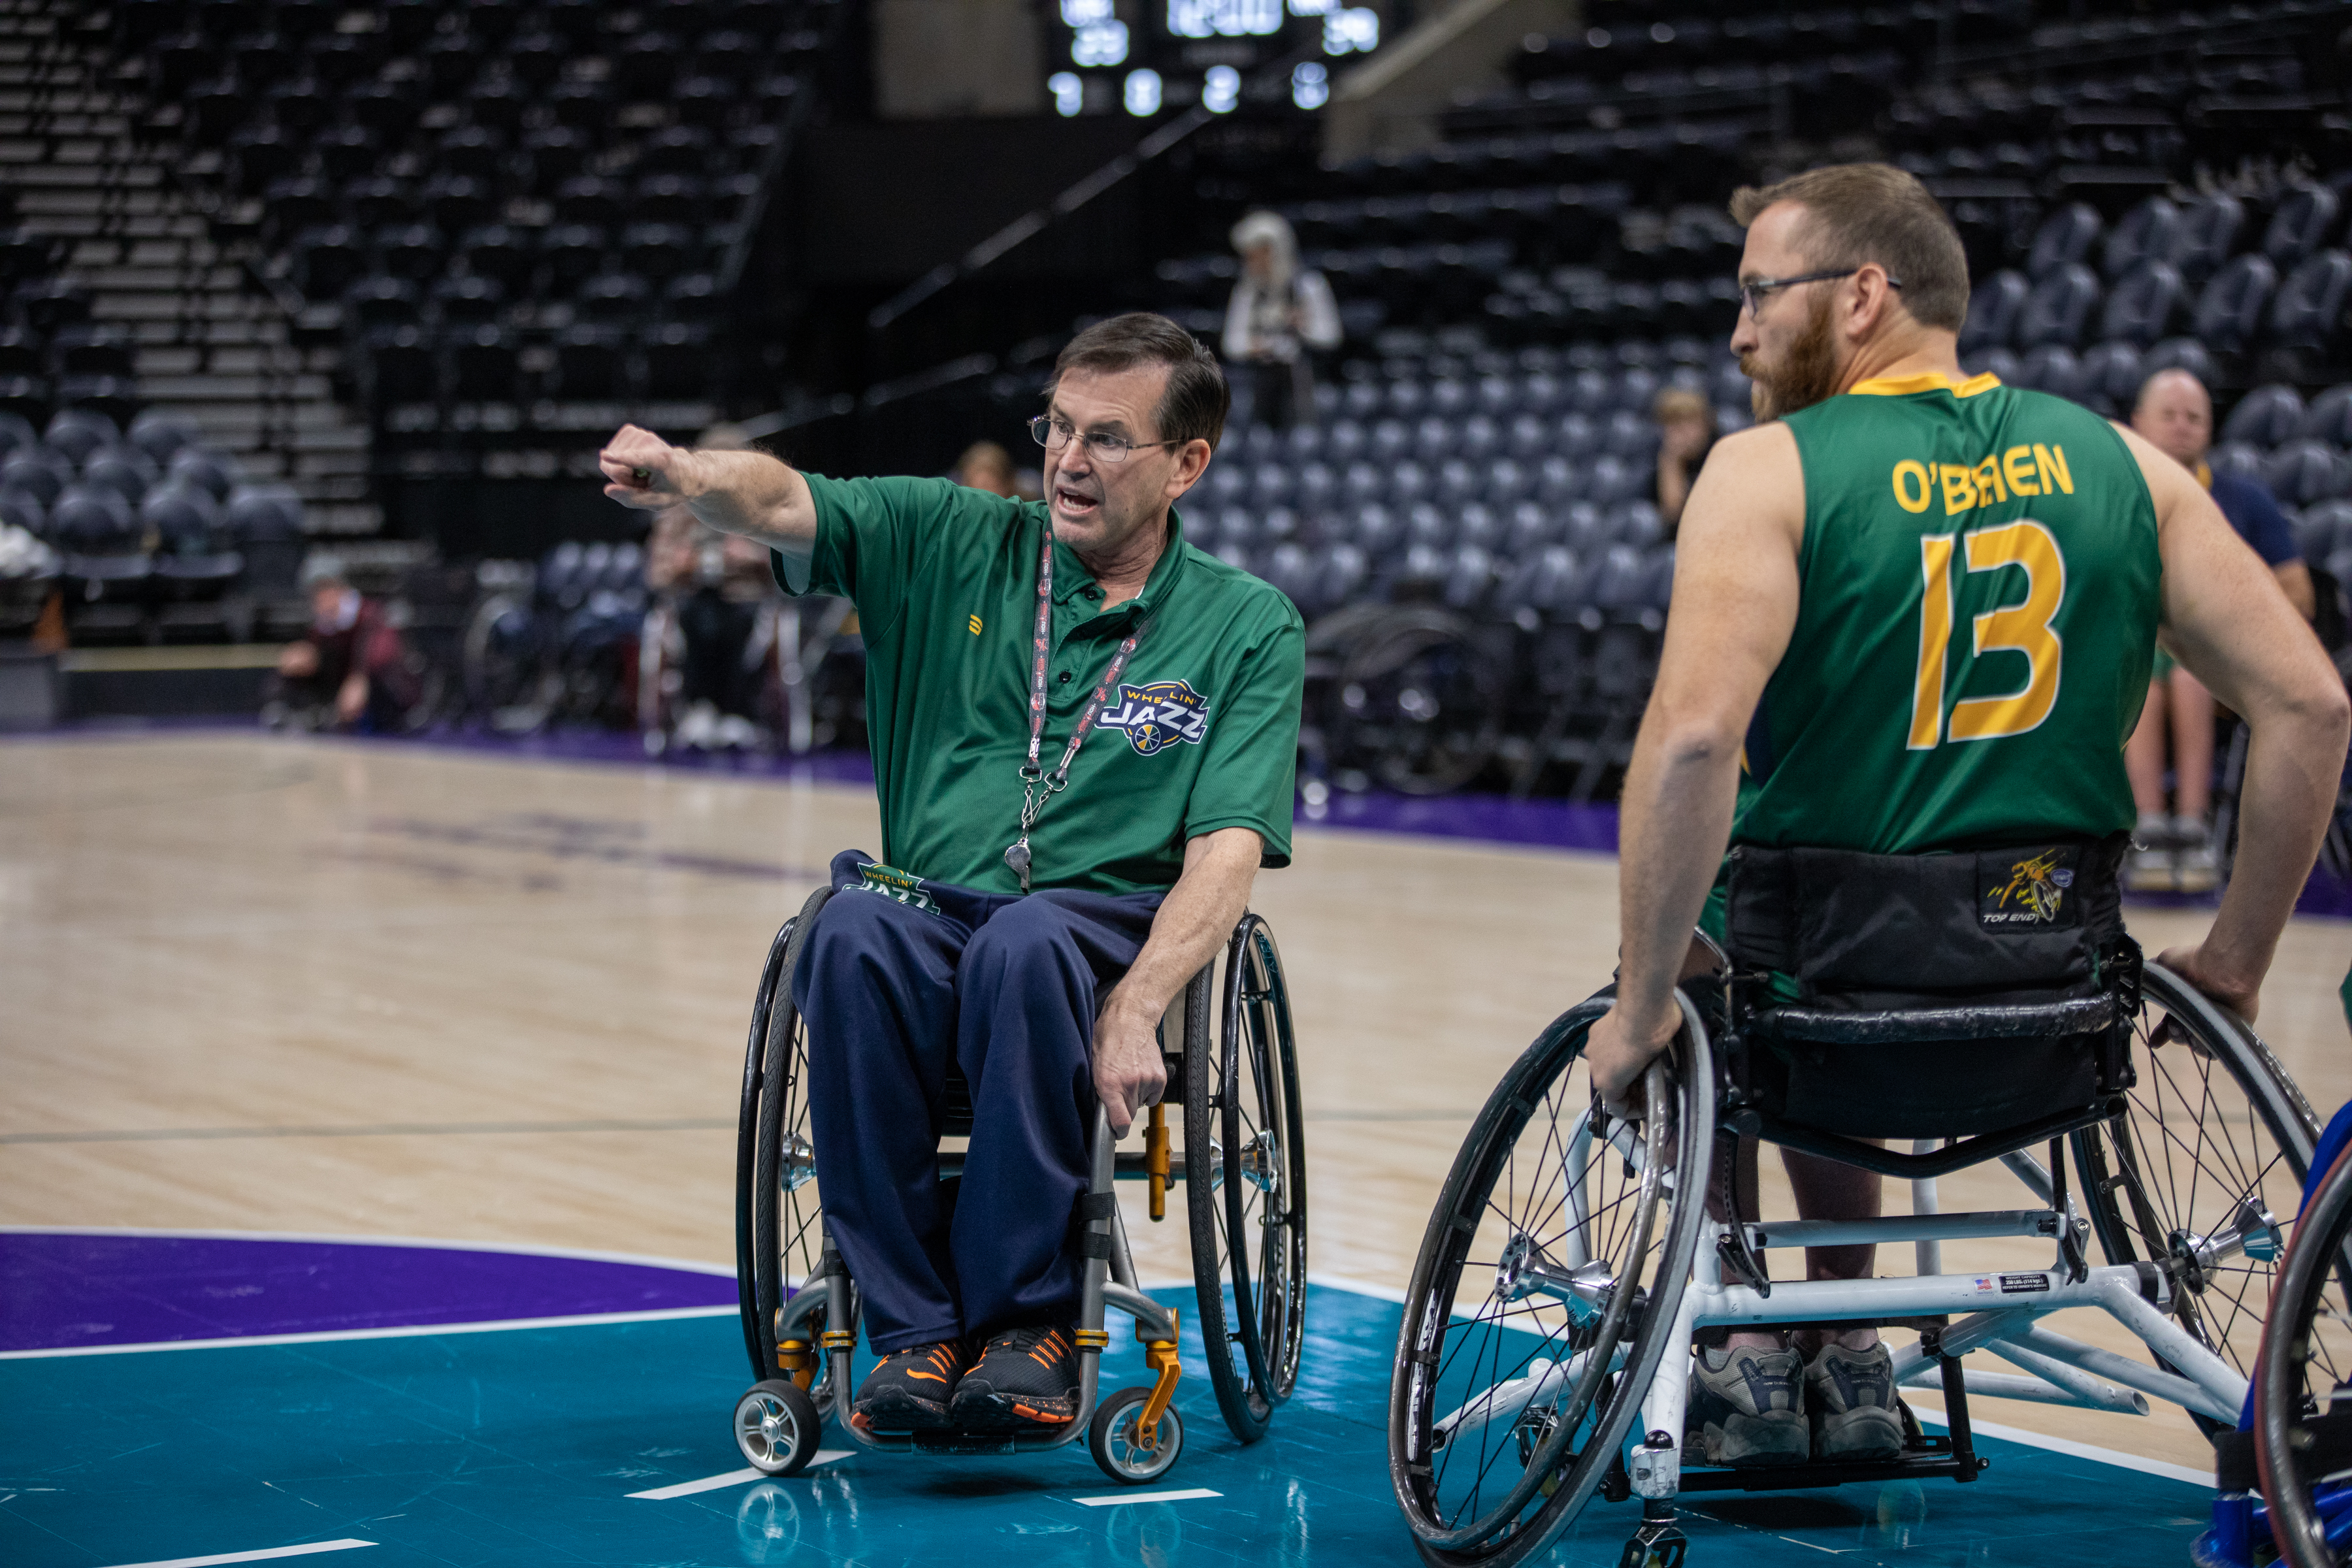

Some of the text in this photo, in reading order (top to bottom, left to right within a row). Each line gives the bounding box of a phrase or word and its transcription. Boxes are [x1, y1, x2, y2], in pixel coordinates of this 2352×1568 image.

[1906, 519, 2066, 750] 13
[1127, 690, 1197, 705] WHELIN'
[1100, 701, 1205, 738] JAZZ
[864, 870, 913, 887] WHEELIN'
[1983, 914, 2008, 923] TOP
